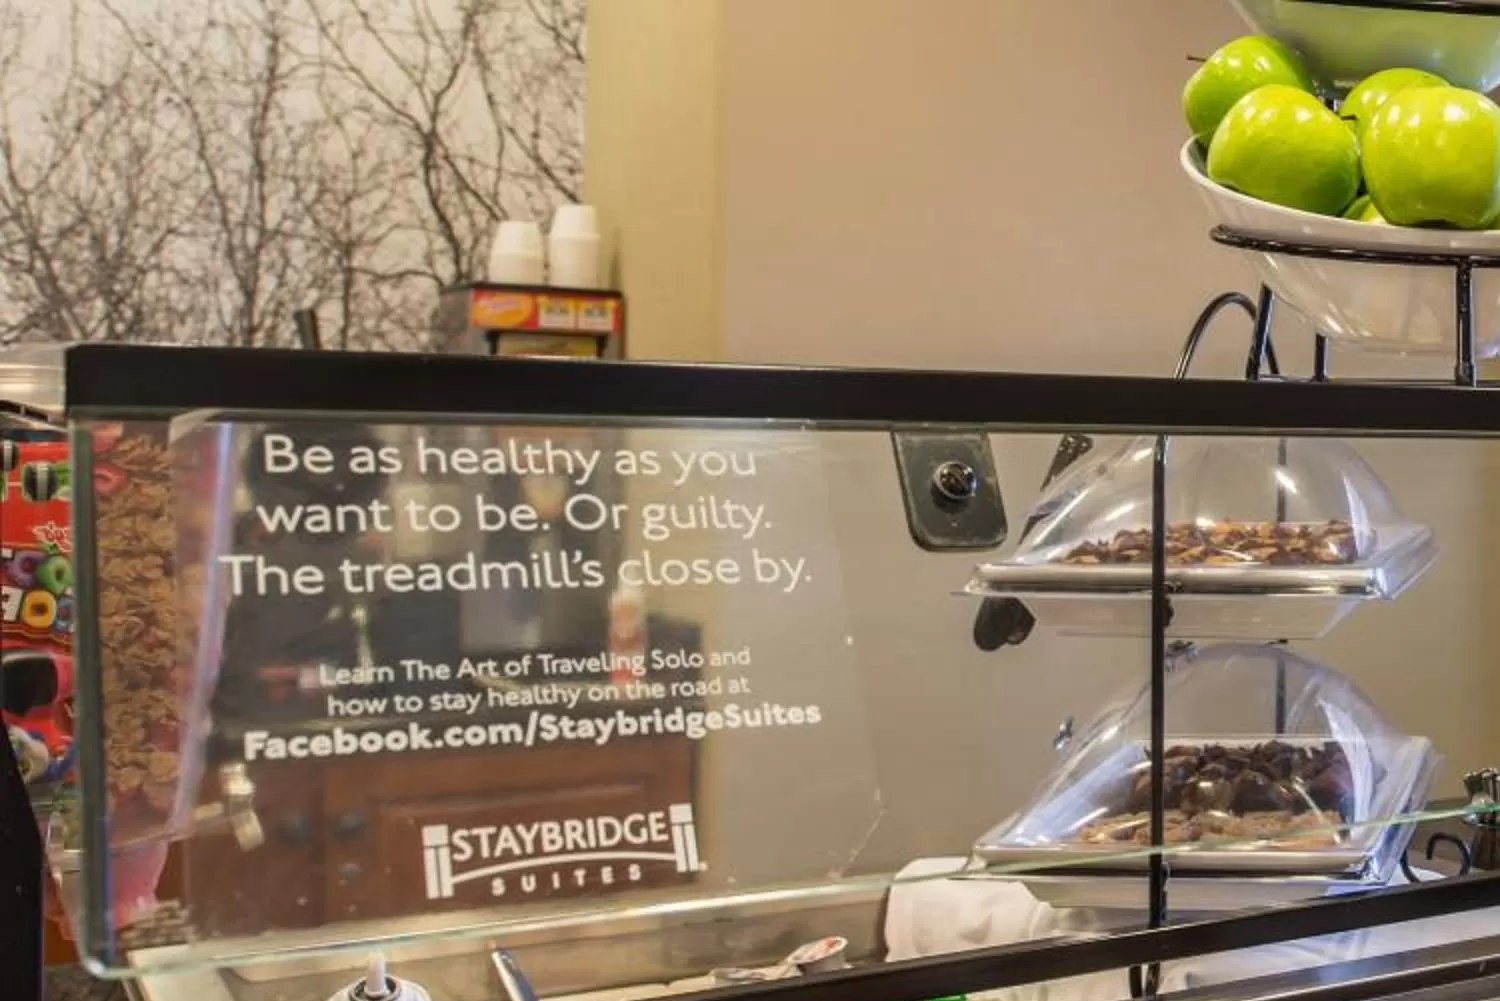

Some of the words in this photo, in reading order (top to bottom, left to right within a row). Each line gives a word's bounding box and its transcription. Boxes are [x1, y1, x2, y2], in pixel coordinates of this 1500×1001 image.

[263, 434, 334, 474] Be
[349, 446, 402, 473] as
[416, 436, 601, 486] healthy
[614, 449, 662, 475] as
[671, 450, 757, 487] you
[255, 499, 393, 533] want
[404, 500, 461, 532] to
[475, 493, 550, 531] be.
[564, 493, 629, 531] Or
[641, 495, 773, 541] guilty.
[217, 554, 325, 597] The
[338, 549, 605, 593] treadmill's
[617, 550, 742, 587] close
[752, 548, 813, 593] by.
[318, 663, 395, 686] Learn
[400, 659, 452, 682] The
[455, 658, 500, 679] Art
[503, 655, 533, 677] of
[536, 653, 647, 677] Traveling
[650, 649, 704, 670] Solo
[708, 646, 752, 665] and
[327, 695, 388, 717] how
[393, 694, 425, 714] to
[429, 691, 482, 716] stay
[486, 684, 582, 709] healthy
[586, 684, 621, 704] on
[624, 680, 666, 700] the
[670, 677, 722, 698] road
[726, 676, 751, 694] at
[243, 703, 823, 761] Facebook.com/StaybridgeSuites
[450, 811, 670, 862] STAYBRIDGE
[490, 863, 642, 896] SUITES
